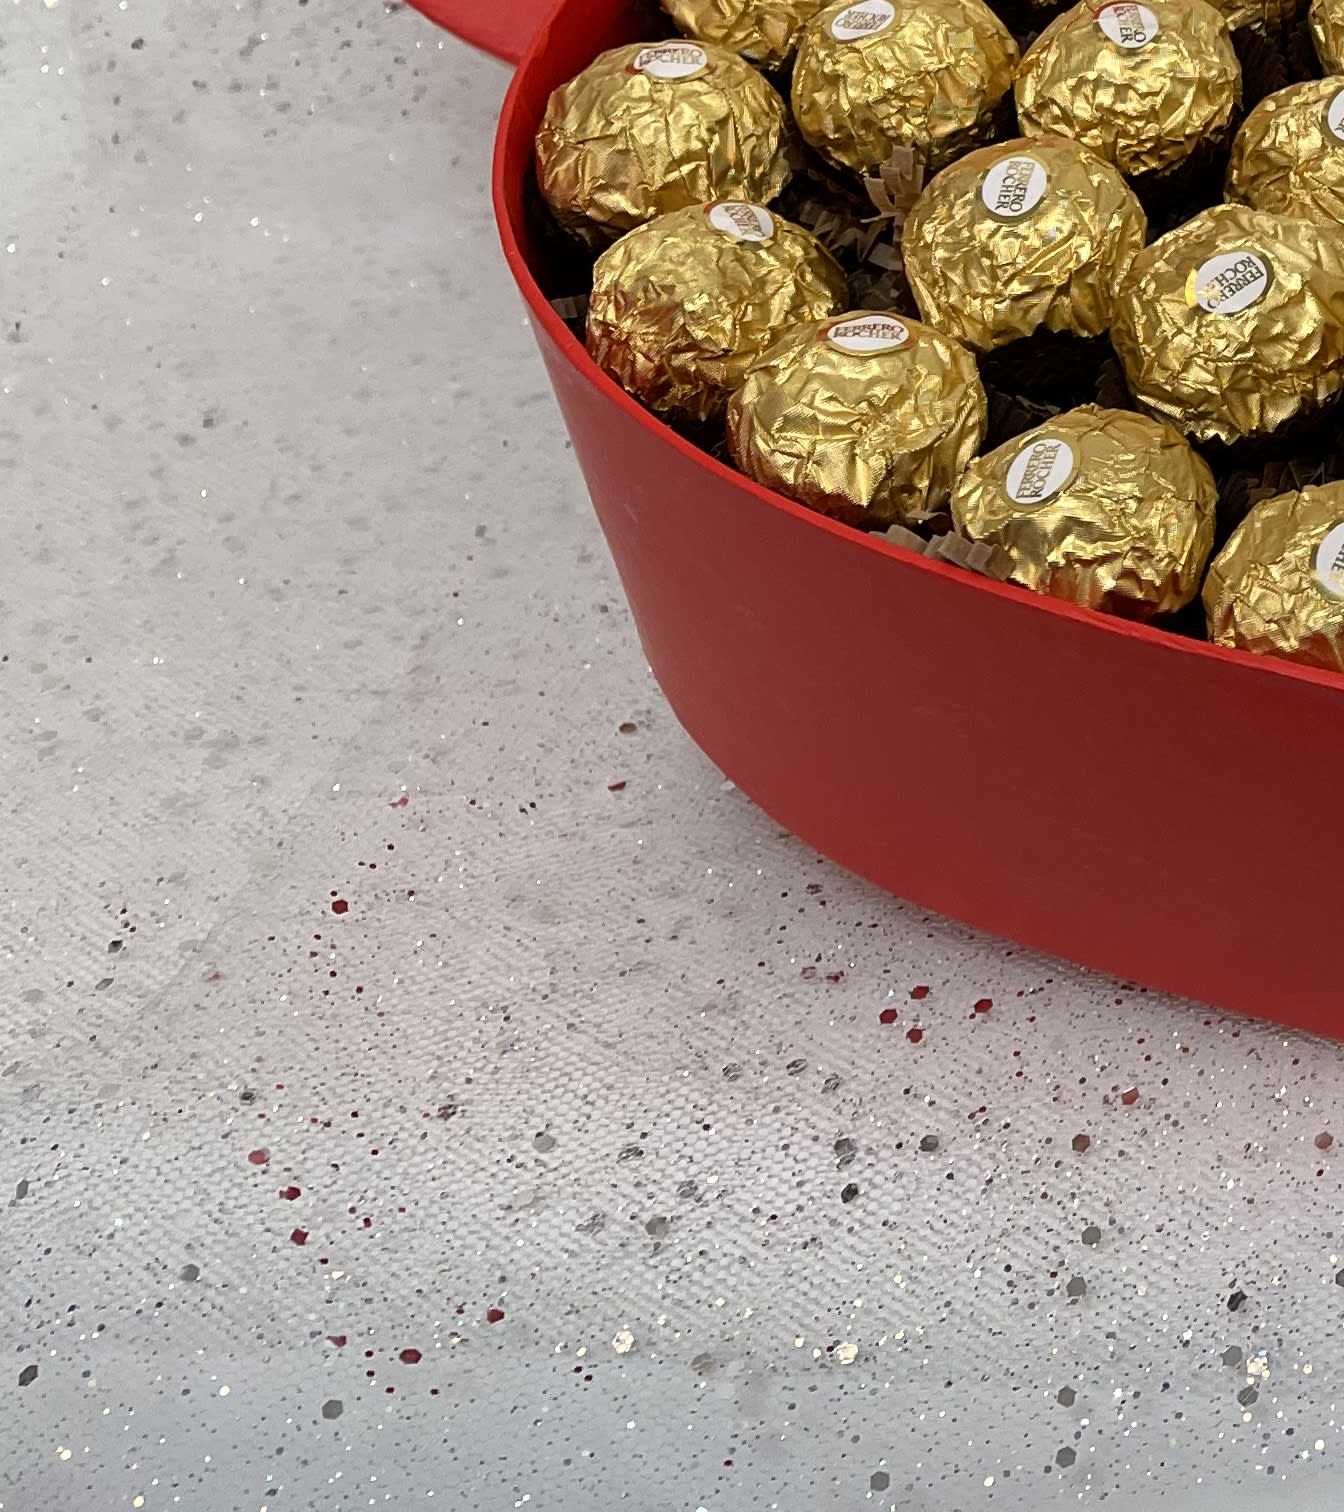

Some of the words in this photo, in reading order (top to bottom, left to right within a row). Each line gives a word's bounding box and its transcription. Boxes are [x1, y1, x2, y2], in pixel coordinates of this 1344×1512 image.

[1009, 161, 1035, 213] FERRERO
[1016, 443, 1047, 499] FERRERO
[1030, 443, 1061, 498] ROCHER
